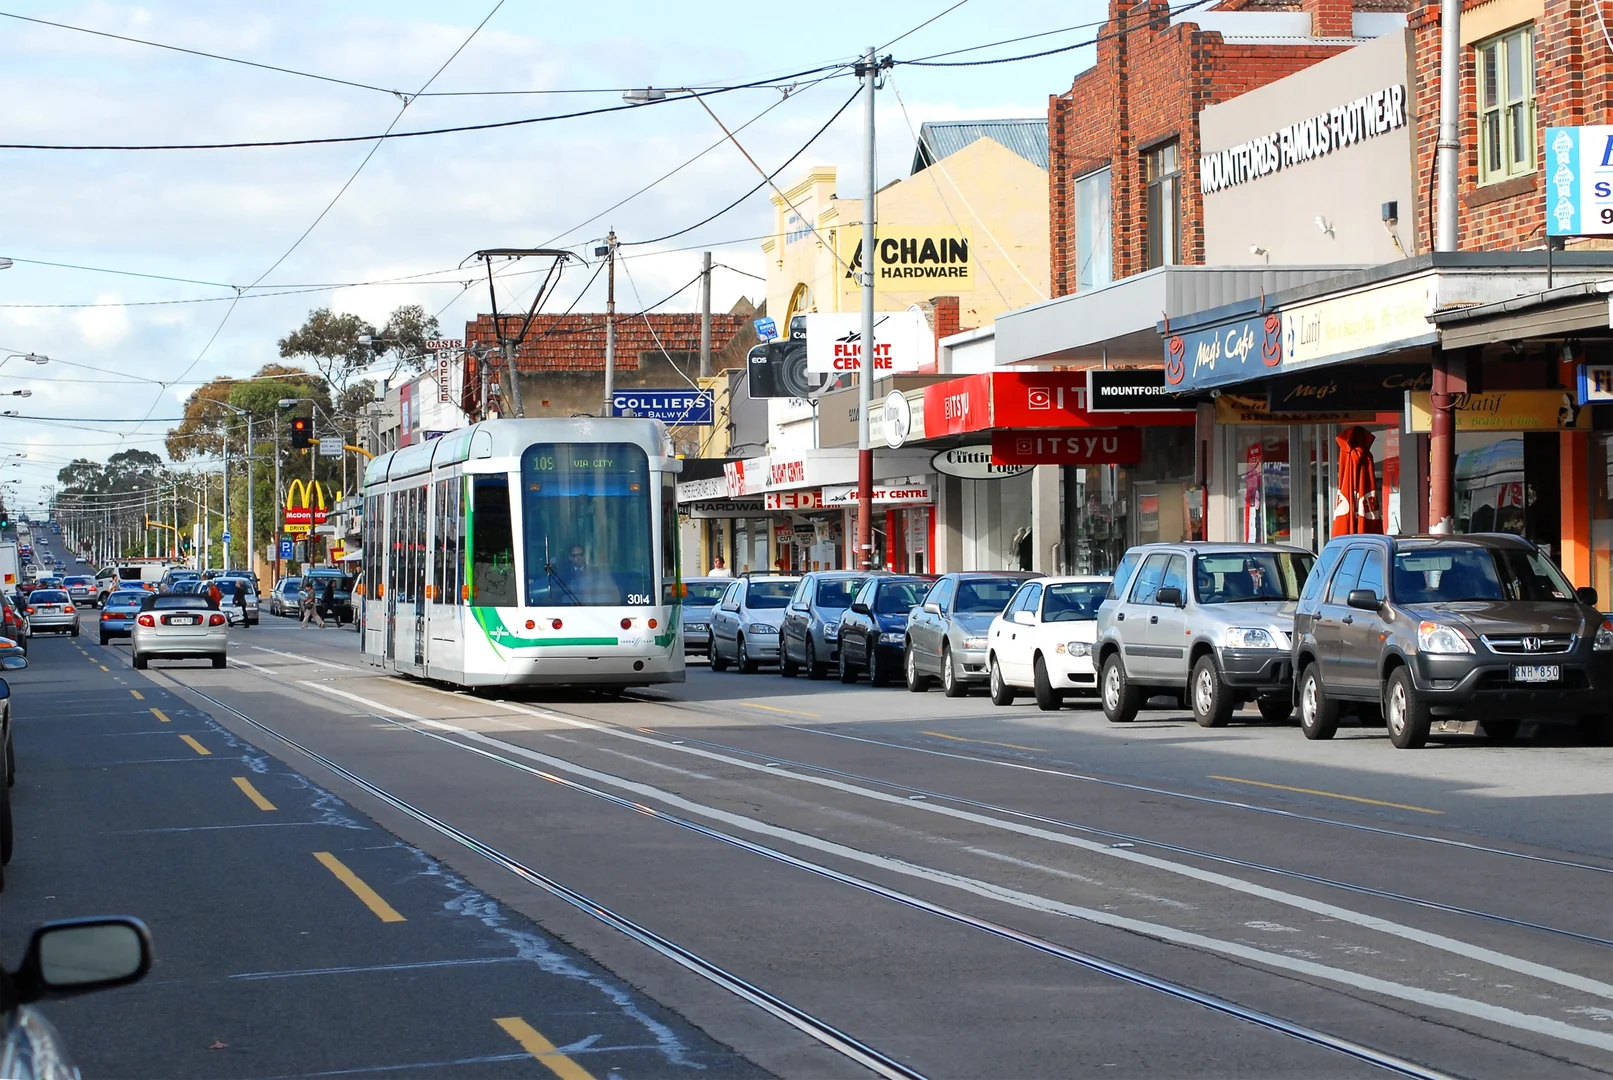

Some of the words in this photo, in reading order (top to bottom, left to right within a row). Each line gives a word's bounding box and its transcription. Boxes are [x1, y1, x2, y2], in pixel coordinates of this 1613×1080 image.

[1199, 132, 1280, 194] MOUNTFORDS
[1279, 112, 1331, 168] FAMOUS
[1330, 84, 1405, 150] FOOTWEAR
[880, 237, 968, 264] CHAIN
[881, 266, 968, 278] HARDWARE
[1300, 309, 1323, 351] Latif
[427, 340, 462, 348] OASIS
[1193, 331, 1221, 378] Meg's
[1224, 324, 1254, 363] Cafe
[833, 357, 892, 369] CENRE
[1283, 380, 1338, 402] Meg's
[889, 489, 928, 499] CENTRE
[627, 594, 650, 605] 3014
[1515, 665, 1533, 677] RNH
[1540, 665, 1558, 677] 850
